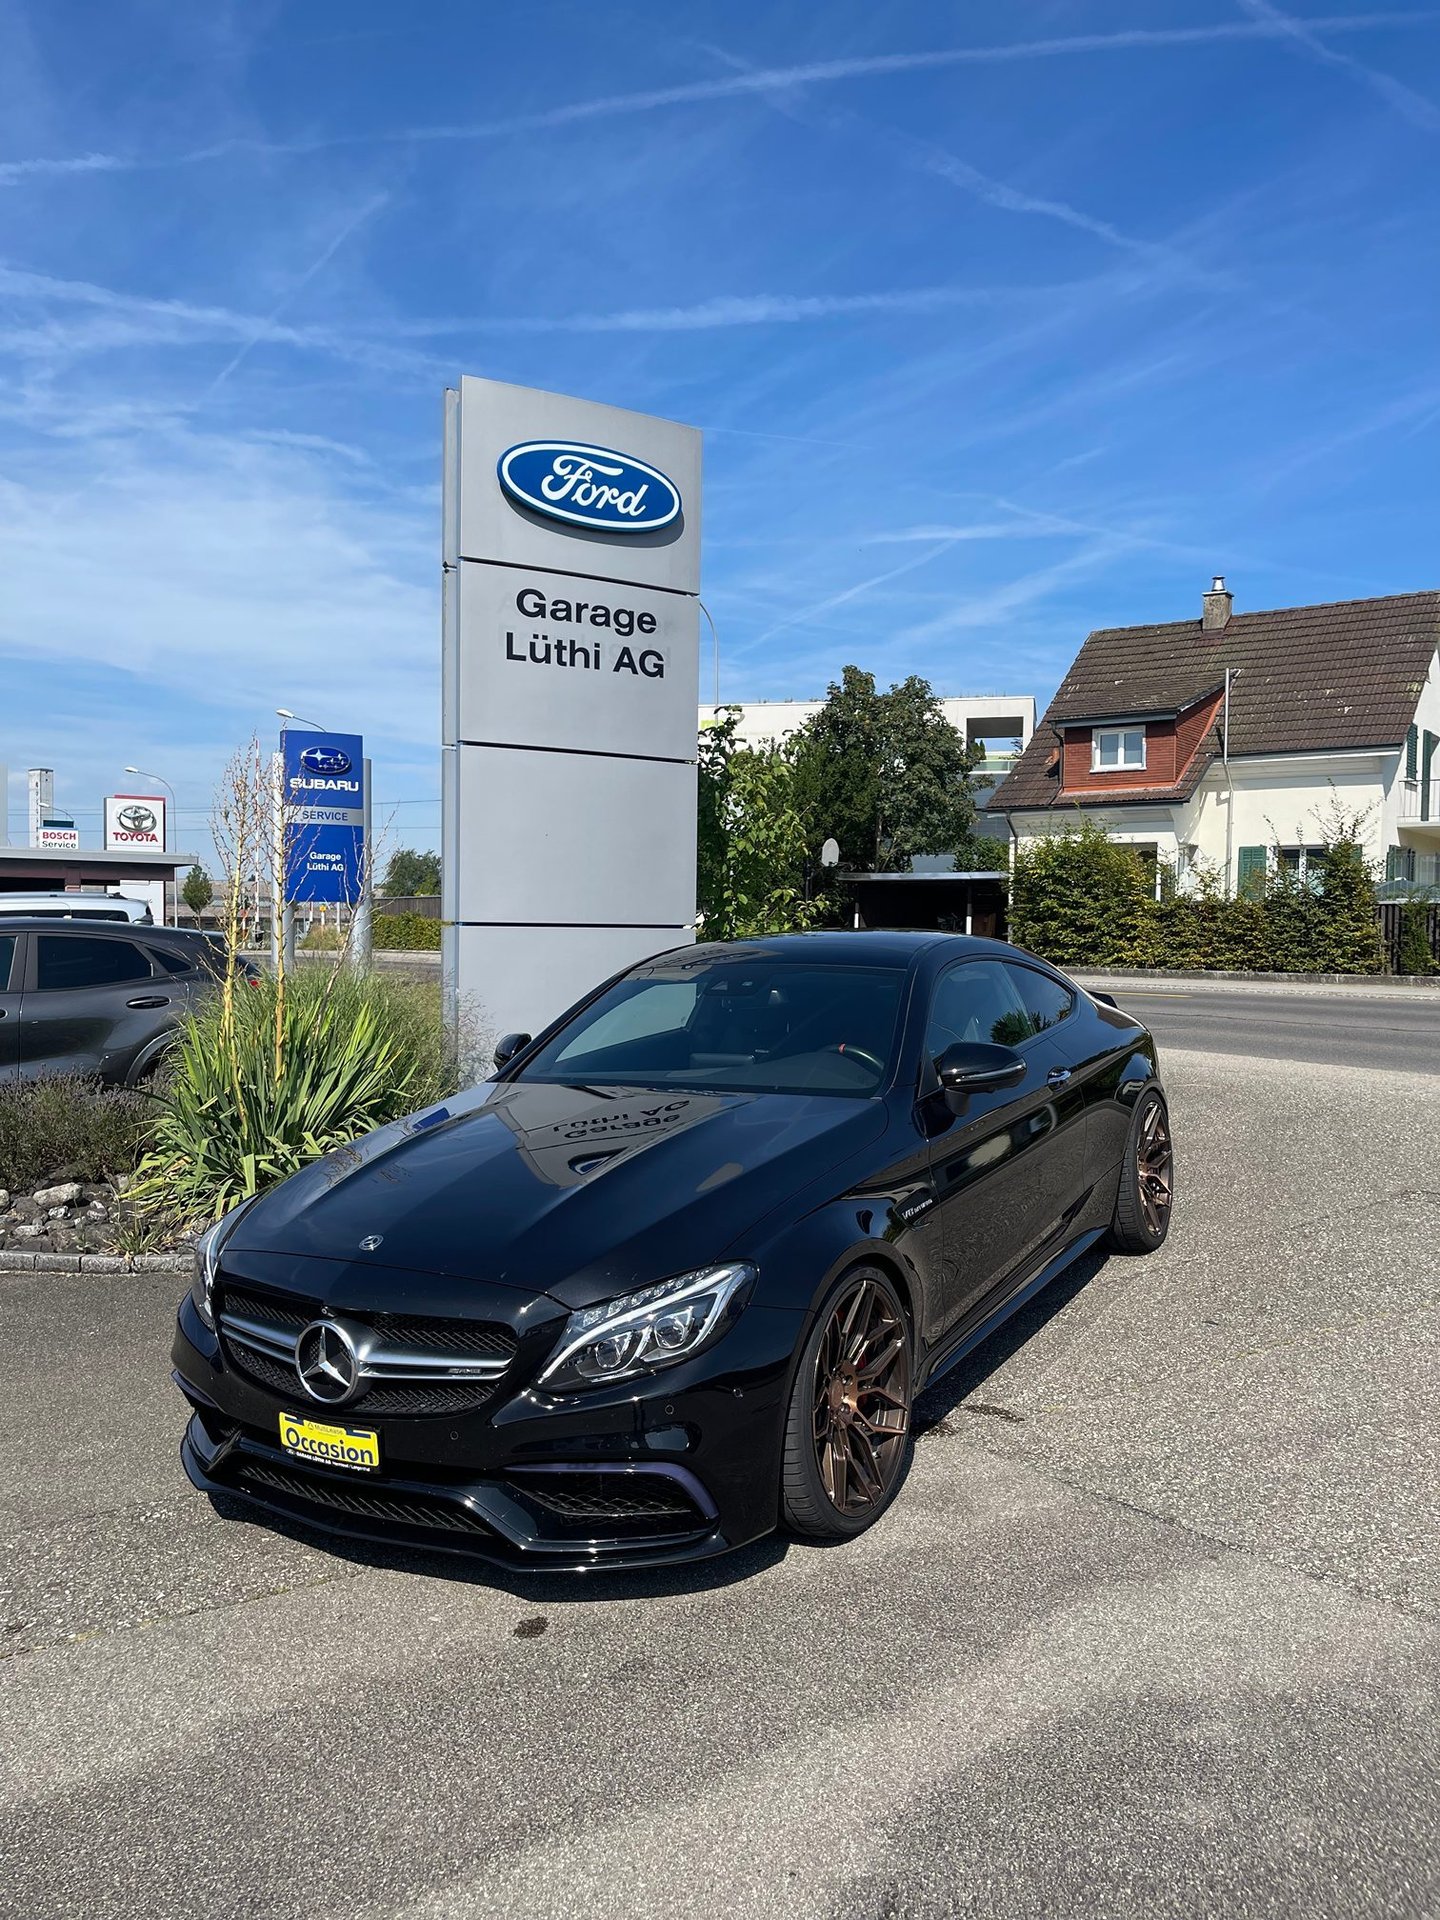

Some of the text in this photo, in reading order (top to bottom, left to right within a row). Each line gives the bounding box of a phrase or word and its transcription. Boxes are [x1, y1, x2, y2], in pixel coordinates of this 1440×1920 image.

[541, 454, 649, 517] Ford
[516, 588, 657, 637] Garage
[506, 631, 665, 679] Lüthi AG
[289, 777, 359, 792] SUBARU
[302, 810, 349, 821] SERVICE
[42, 832, 76, 841] BOSCH
[113, 832, 158, 843] TOYOTA
[42, 841, 76, 849] Service
[309, 851, 342, 862] Garage
[307, 862, 344, 872] Lüthi AG
[286, 1427, 374, 1465] Occasion
